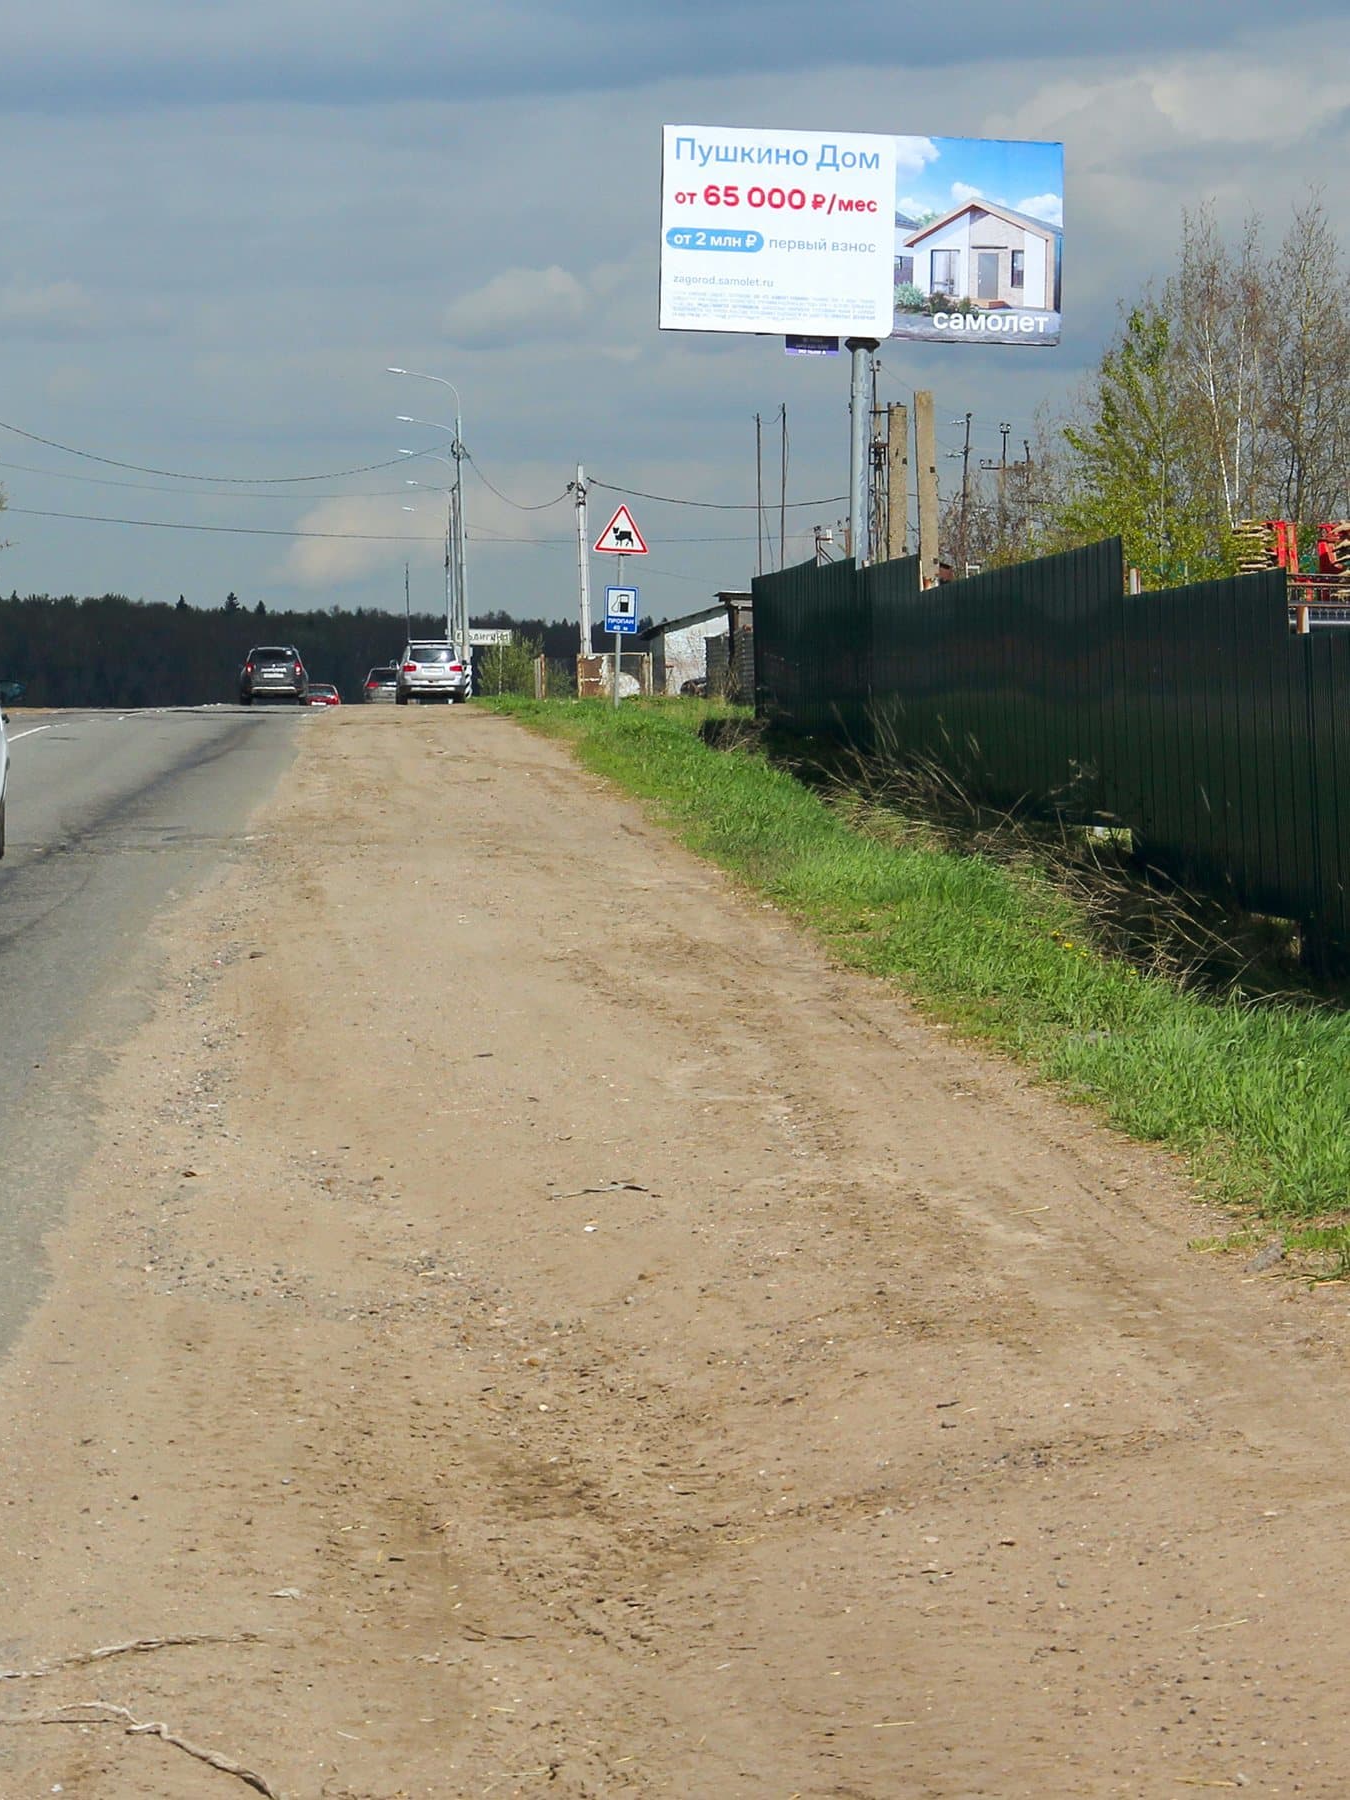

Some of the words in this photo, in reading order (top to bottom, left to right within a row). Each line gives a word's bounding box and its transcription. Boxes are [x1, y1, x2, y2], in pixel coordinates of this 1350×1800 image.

[675, 138, 808, 167] Пушкино
[816, 145, 880, 171] Дом
[675, 192, 697, 205] от
[703, 185, 739, 207] 65
[747, 187, 806, 210] 000
[674, 235, 692, 245] от
[695, 232, 707, 245] 2
[710, 236, 741, 247] млн
[769, 237, 827, 252] первый
[831, 241, 876, 253] взнос
[673, 274, 774, 288] zagorod.samolet.ru
[933, 312, 1049, 333] самолет
